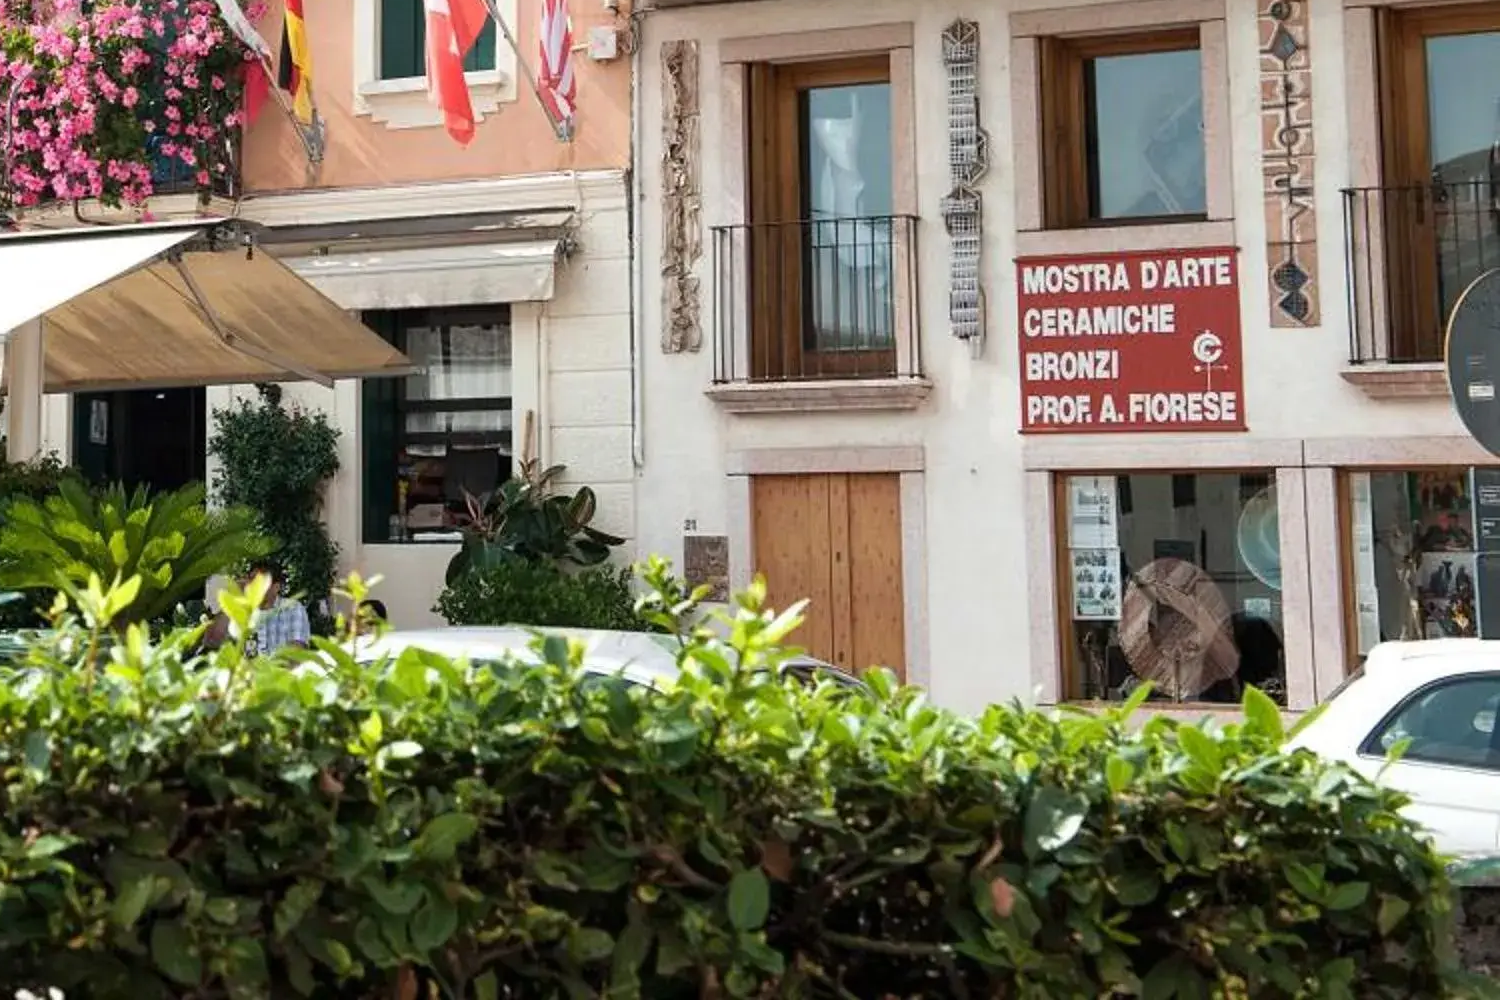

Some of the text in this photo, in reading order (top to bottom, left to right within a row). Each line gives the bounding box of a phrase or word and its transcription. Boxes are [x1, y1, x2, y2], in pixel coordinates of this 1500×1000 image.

[1022, 256, 1232, 294] MOSTRA D'ARTE
[1024, 304, 1176, 337] CERAMICHE
[1025, 350, 1120, 381] BRONZI
[1026, 391, 1236, 424] PROF. A. FIORESE
